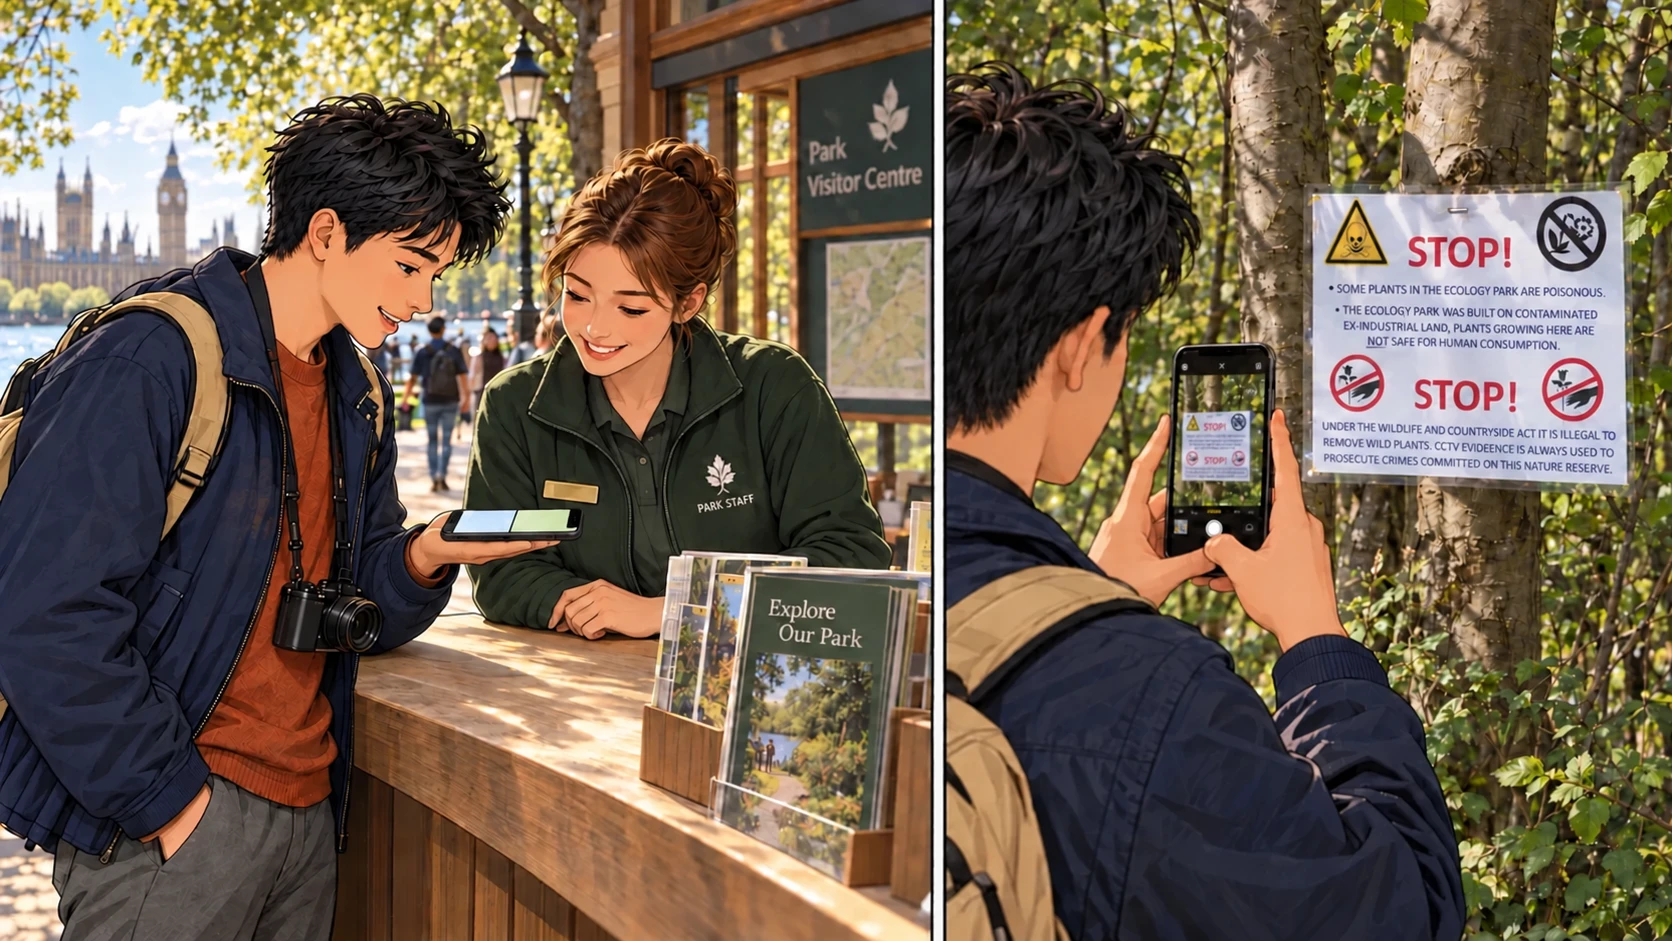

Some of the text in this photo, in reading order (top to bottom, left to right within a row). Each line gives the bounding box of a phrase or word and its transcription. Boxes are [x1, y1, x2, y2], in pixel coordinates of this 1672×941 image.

[808, 136, 847, 164] Park
[807, 165, 923, 197] Visitor Centre
[1408, 236, 1511, 268] STOP!
[1337, 284, 1606, 298] SOME PLANTS IN THE ECOLOGY PARK ARE POISONOUS.
[1343, 305, 1598, 319] THE ECOLOGY PARK WAS BUILT ON CONTAMINATED
[1343, 321, 1594, 336] EX-INDUSTRIAL LAND, PLANTS GROWING HERE ARE
[1366, 336, 1560, 350] NOT SAFE FOR HUMAN CONSUMPTION.
[1414, 379, 1517, 412] STOP!
[1322, 422, 1616, 440] UNDER THE WILDLIFE AND COUNTRYSIDE ACT IT IS ILLEGAL TO
[1324, 438, 1614, 458] REMOVE WILD PLANTS. CCTV EVIDEENCE IS ALWAYS USED TO
[1324, 454, 1612, 474] PROSECUTE CRIMES COMMITTED ON THIS NATURE RESERVE.
[697, 494, 755, 513] PARK STAFF
[768, 598, 836, 623] Explore
[779, 624, 862, 648] Our Park
